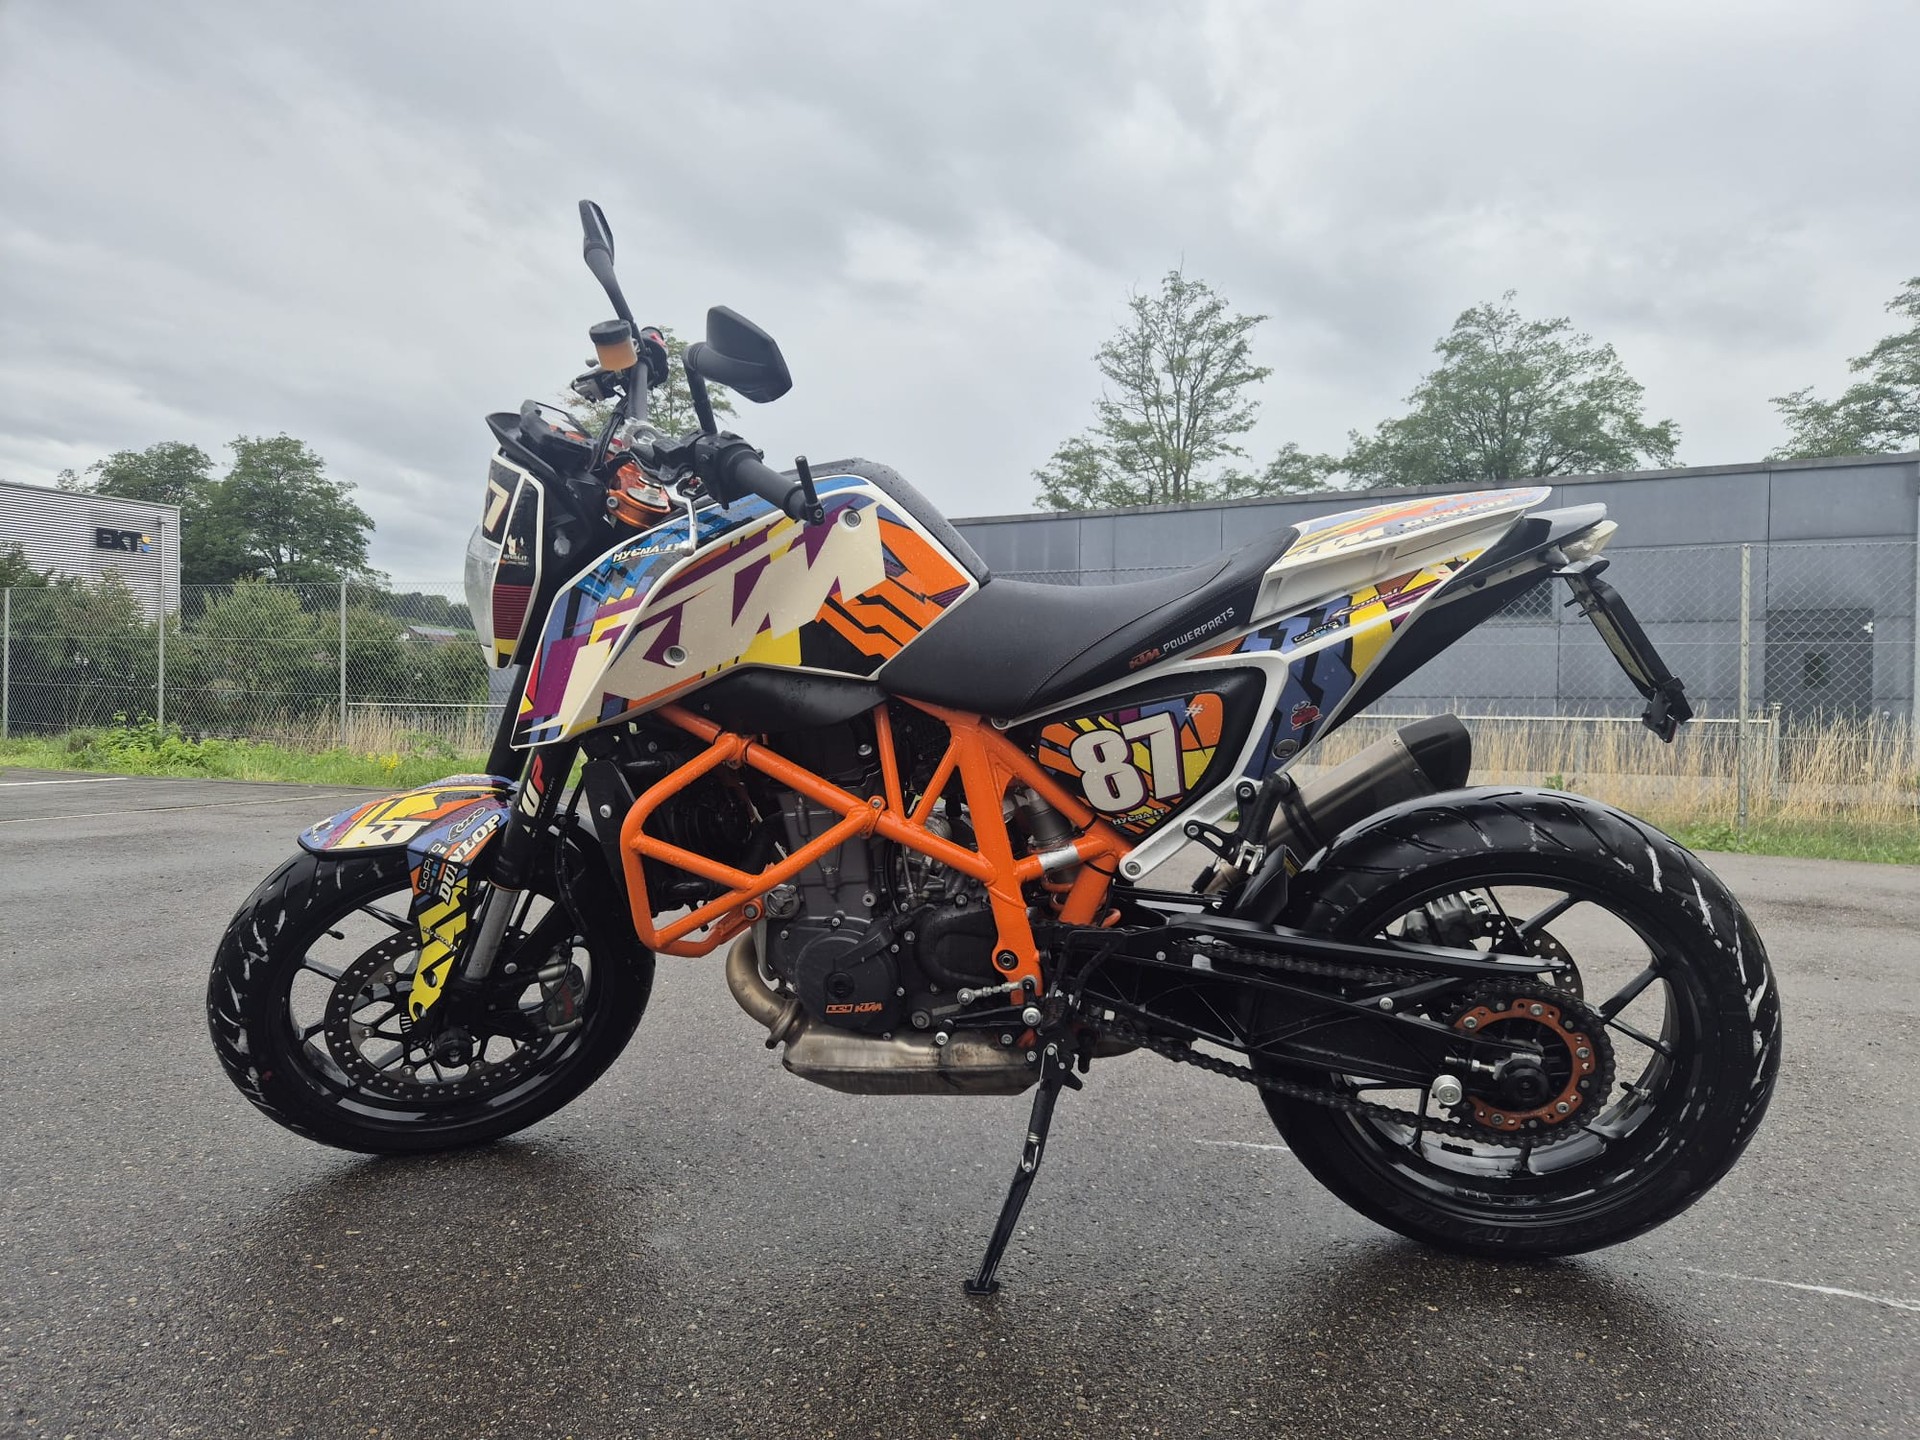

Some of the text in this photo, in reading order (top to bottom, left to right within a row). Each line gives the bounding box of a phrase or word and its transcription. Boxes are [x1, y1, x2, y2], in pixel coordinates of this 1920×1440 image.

[519, 500, 886, 735] KTM
[1163, 606, 1236, 653] POWERPARTS
[1293, 621, 1339, 642] GoPro
[1070, 711, 1182, 812] 87
